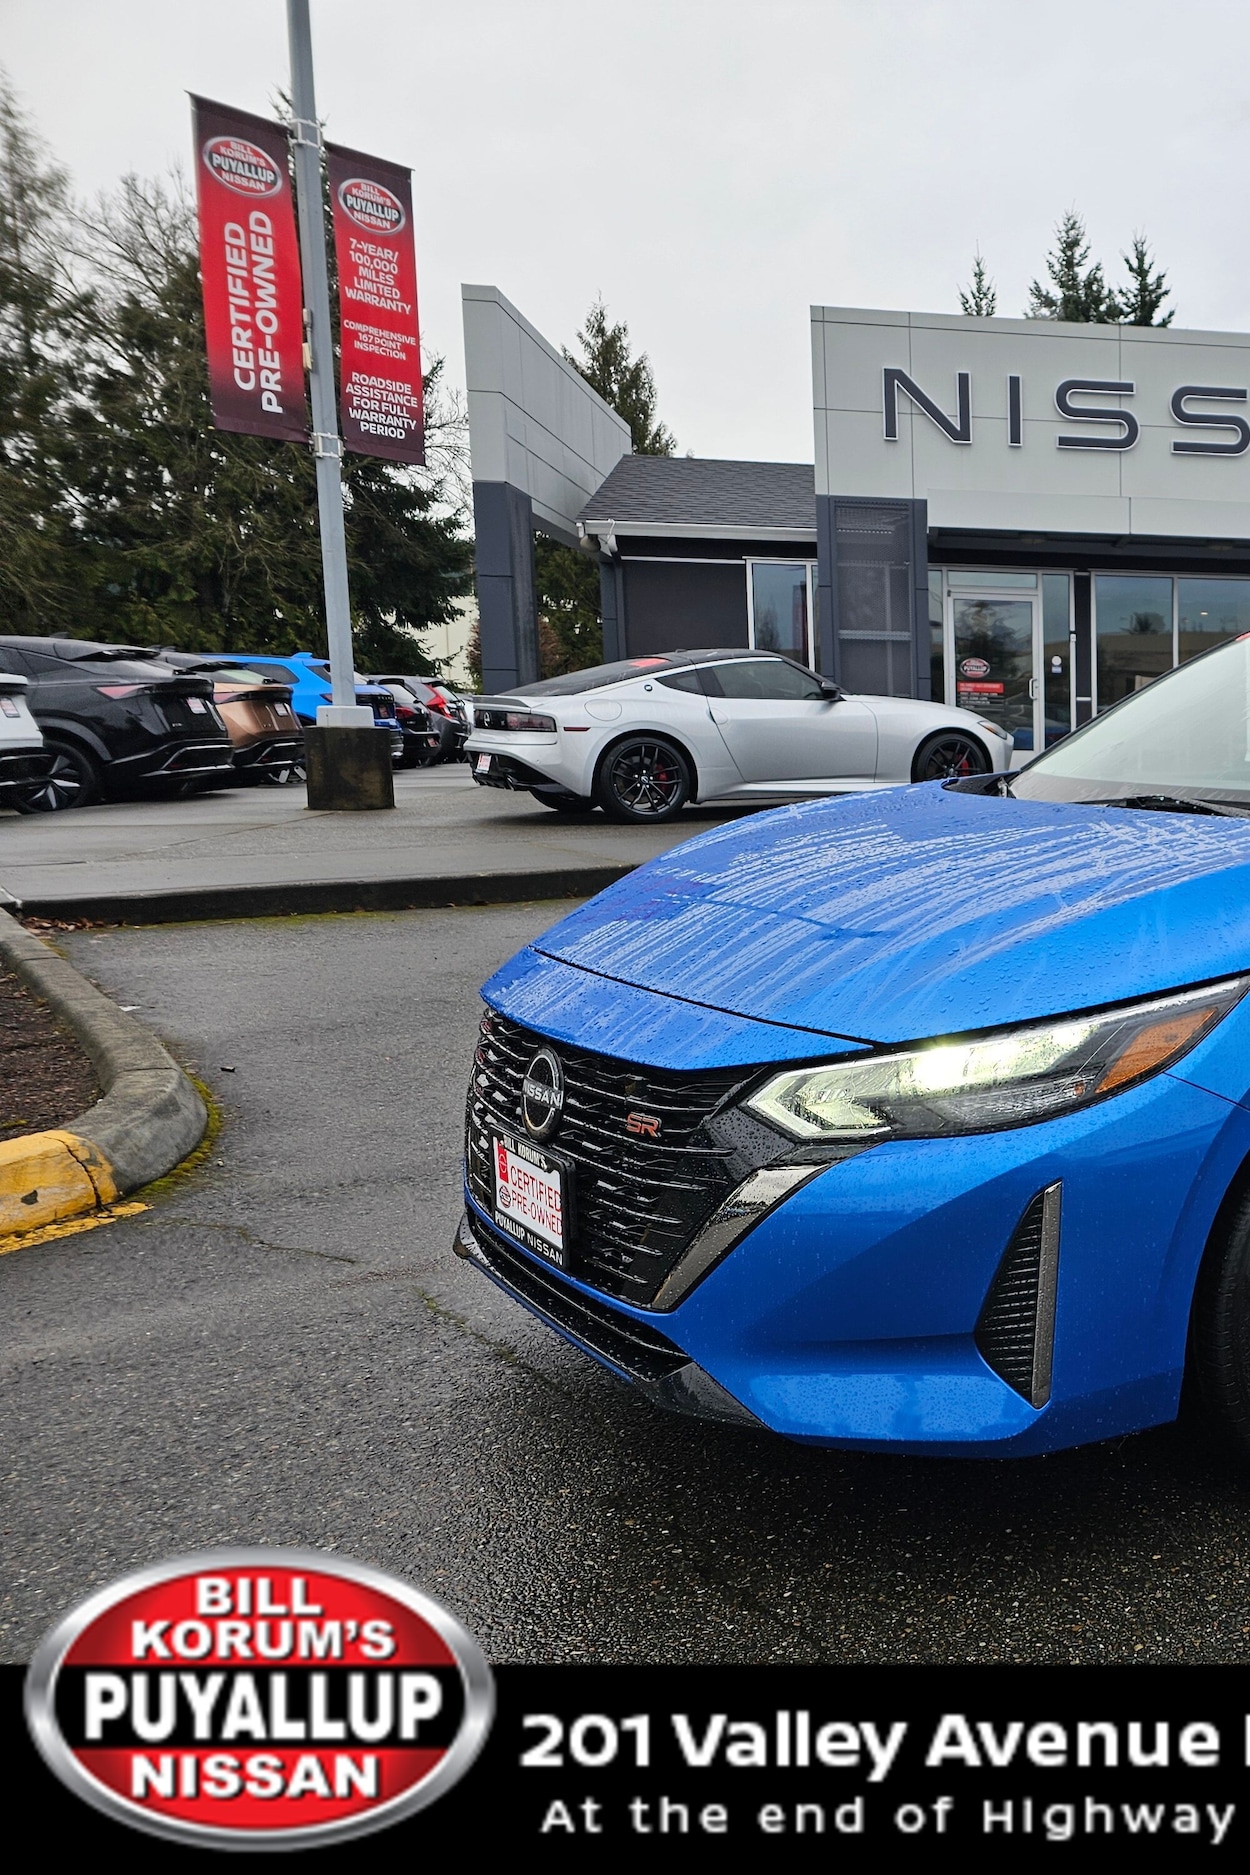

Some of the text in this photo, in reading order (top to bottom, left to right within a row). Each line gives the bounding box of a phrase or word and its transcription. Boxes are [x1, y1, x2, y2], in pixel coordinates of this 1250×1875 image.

[220, 146, 266, 166] KORUM'S
[230, 141, 254, 155] BILL
[212, 153, 274, 183] PUYALLUP
[222, 171, 266, 191] NISSAN
[360, 183, 380, 196] BILL
[346, 195, 399, 221] PUYALLUP
[352, 187, 392, 206] KORUM'S
[353, 210, 390, 229] NISSAN
[349, 237, 399, 262] 7-YEAR/
[349, 250, 398, 274] 100,000
[354, 276, 400, 299] LIMITED
[359, 266, 395, 286] MILES
[224, 222, 256, 391] CERTIFIED
[249, 210, 283, 414] PRE-OWNED
[345, 286, 411, 315] WARRANTY
[344, 319, 416, 345] COMPREHENSIVE
[358, 332, 401, 350] 167 POINT
[354, 340, 406, 360] INSPECTION
[346, 383, 418, 407] ASSISTANCE
[352, 372, 412, 394] ROADSIDE
[349, 407, 417, 430] WARRANTY
[353, 396, 410, 417] FOR FULL
[360, 421, 406, 439] PERIOD
[523, 1078, 564, 1110] NISSAN
[626, 1112, 661, 1137] SR
[517, 1142, 547, 1170] KORUM'S
[510, 1165, 562, 1212] CERTIFIED
[512, 1189, 563, 1236] PRE-OWNED
[495, 1210, 562, 1266] PUYALLUP NISSAN
